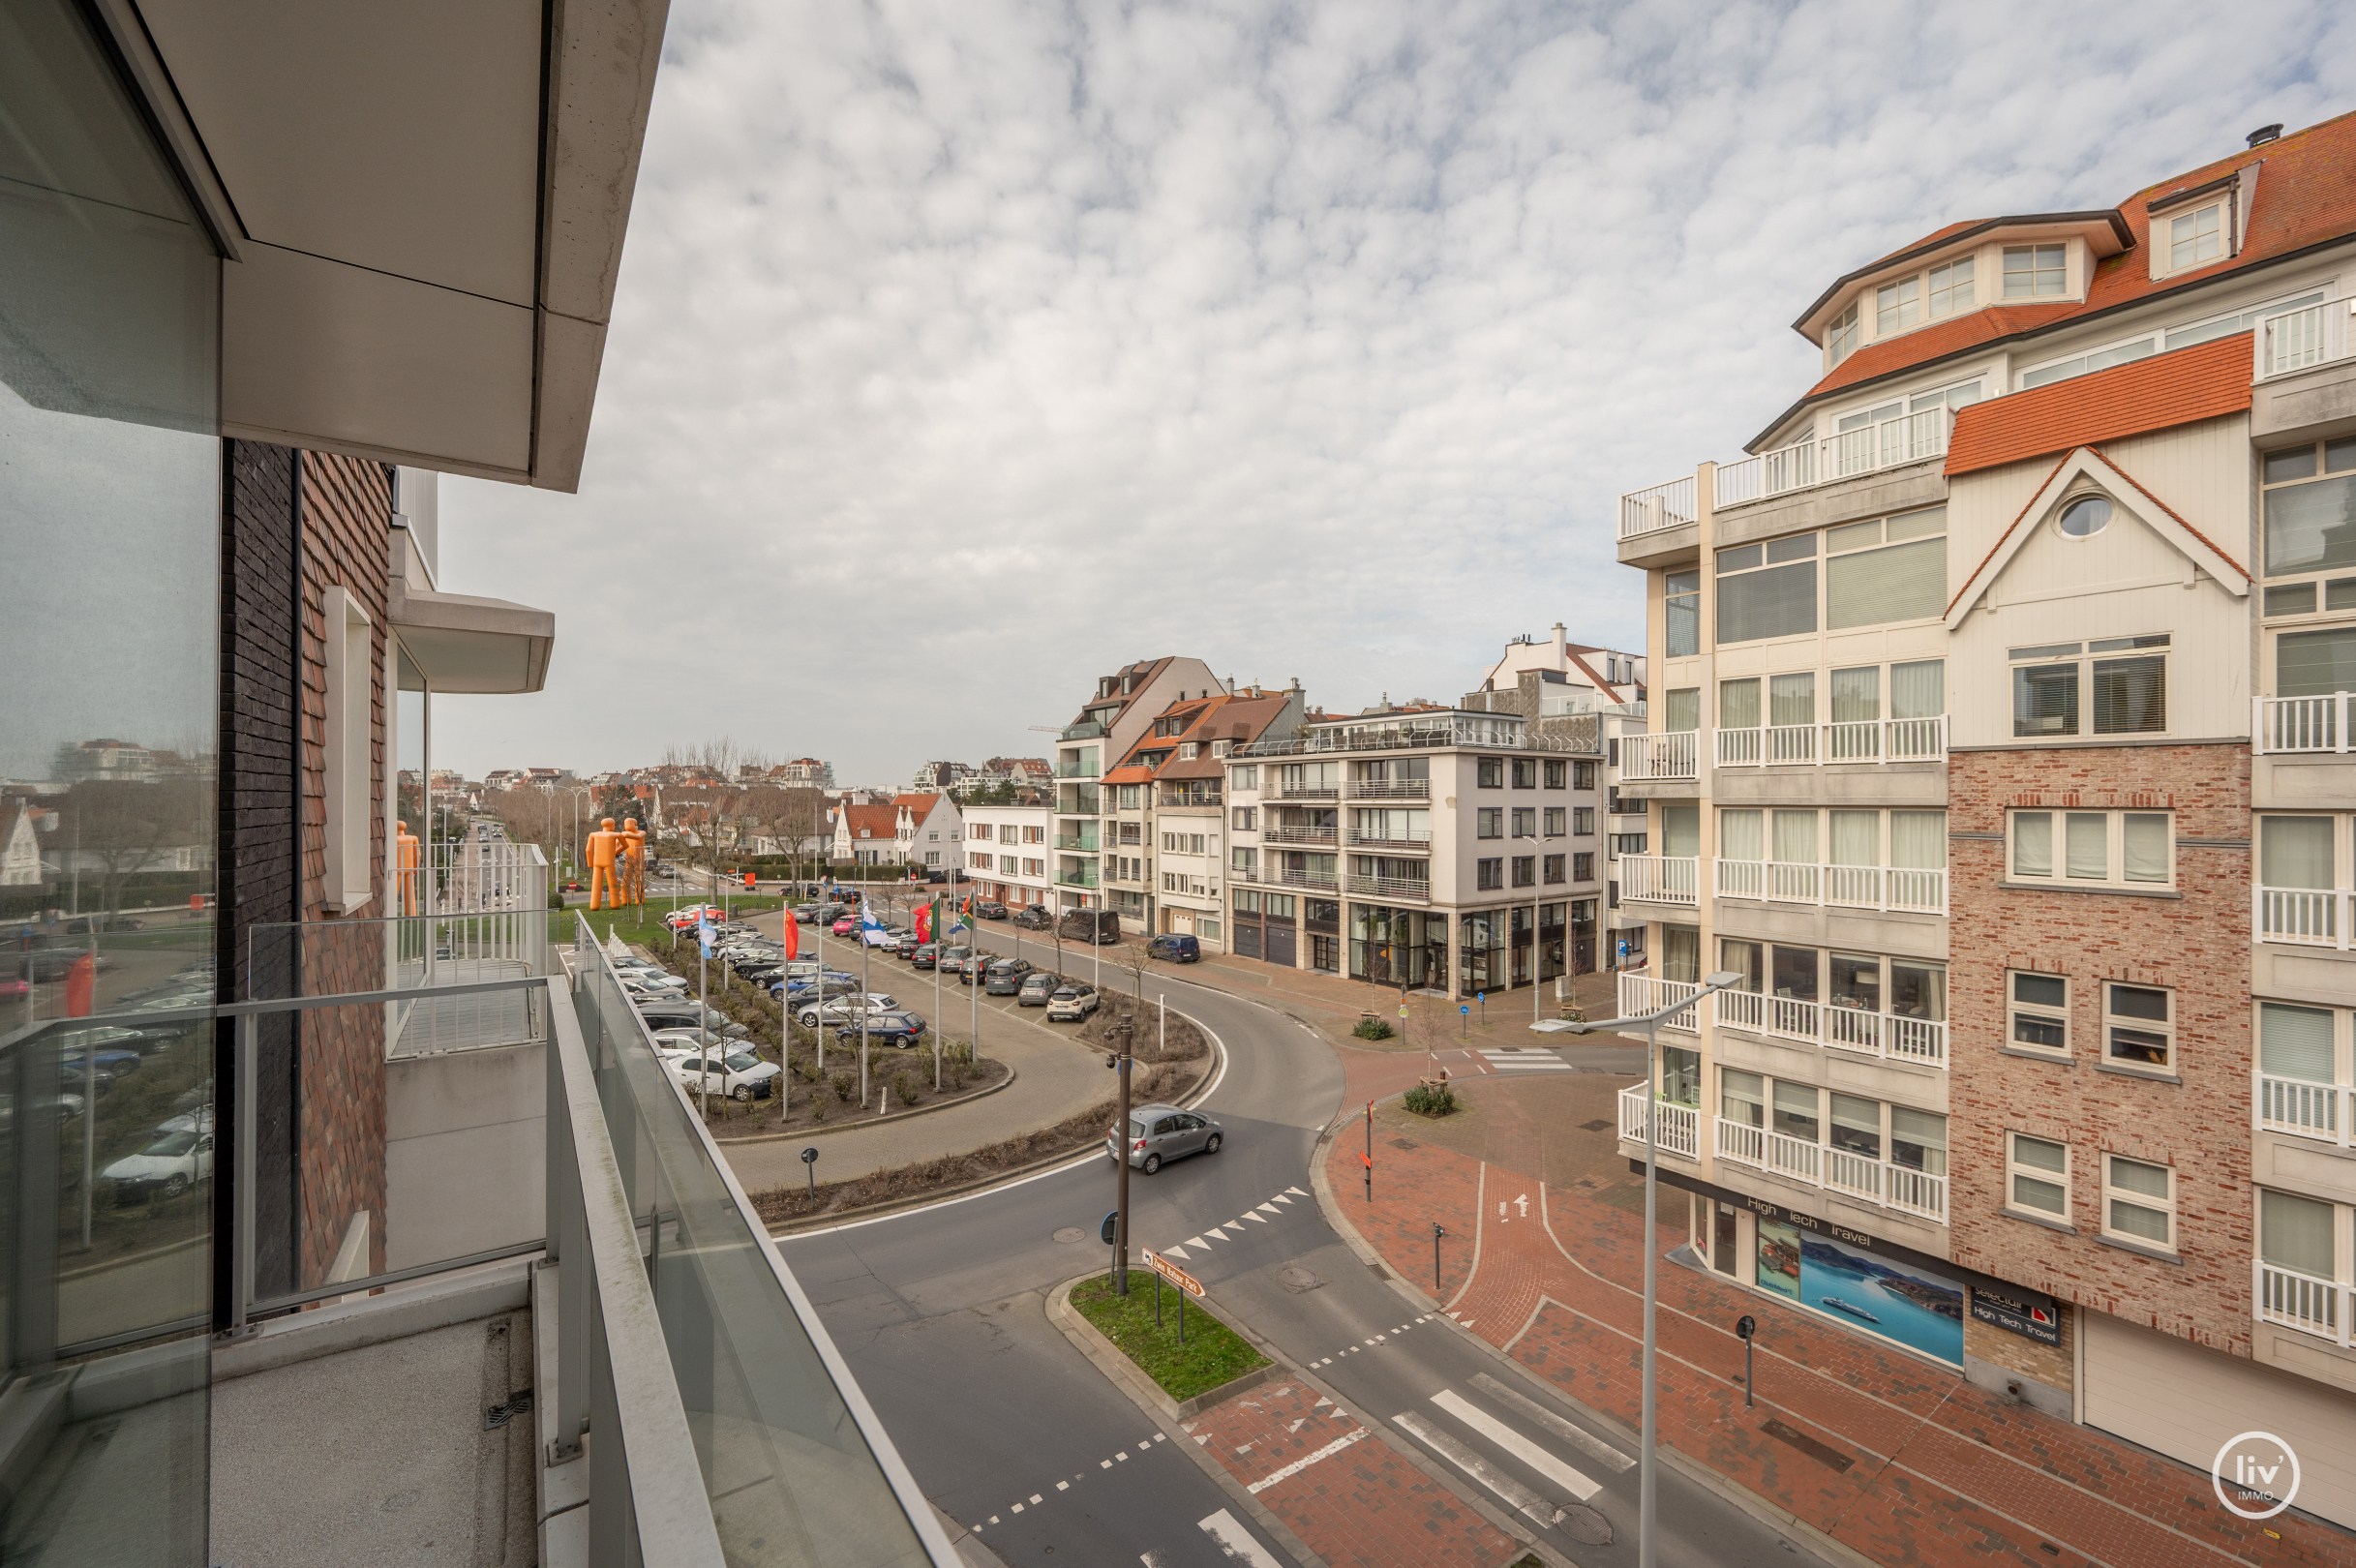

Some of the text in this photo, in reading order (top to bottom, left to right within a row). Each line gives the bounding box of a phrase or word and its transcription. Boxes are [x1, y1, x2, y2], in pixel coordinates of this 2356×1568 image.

[1618, 941, 1626, 950] P
[1747, 1196, 1870, 1247] High Tech Travel
[1154, 1258, 1165, 1273] Zwin
[1185, 1279, 1197, 1293] Park
[1974, 1306, 1996, 1320] High
[1999, 1314, 2022, 1330] Tech
[2025, 1323, 2056, 1342] Travel
